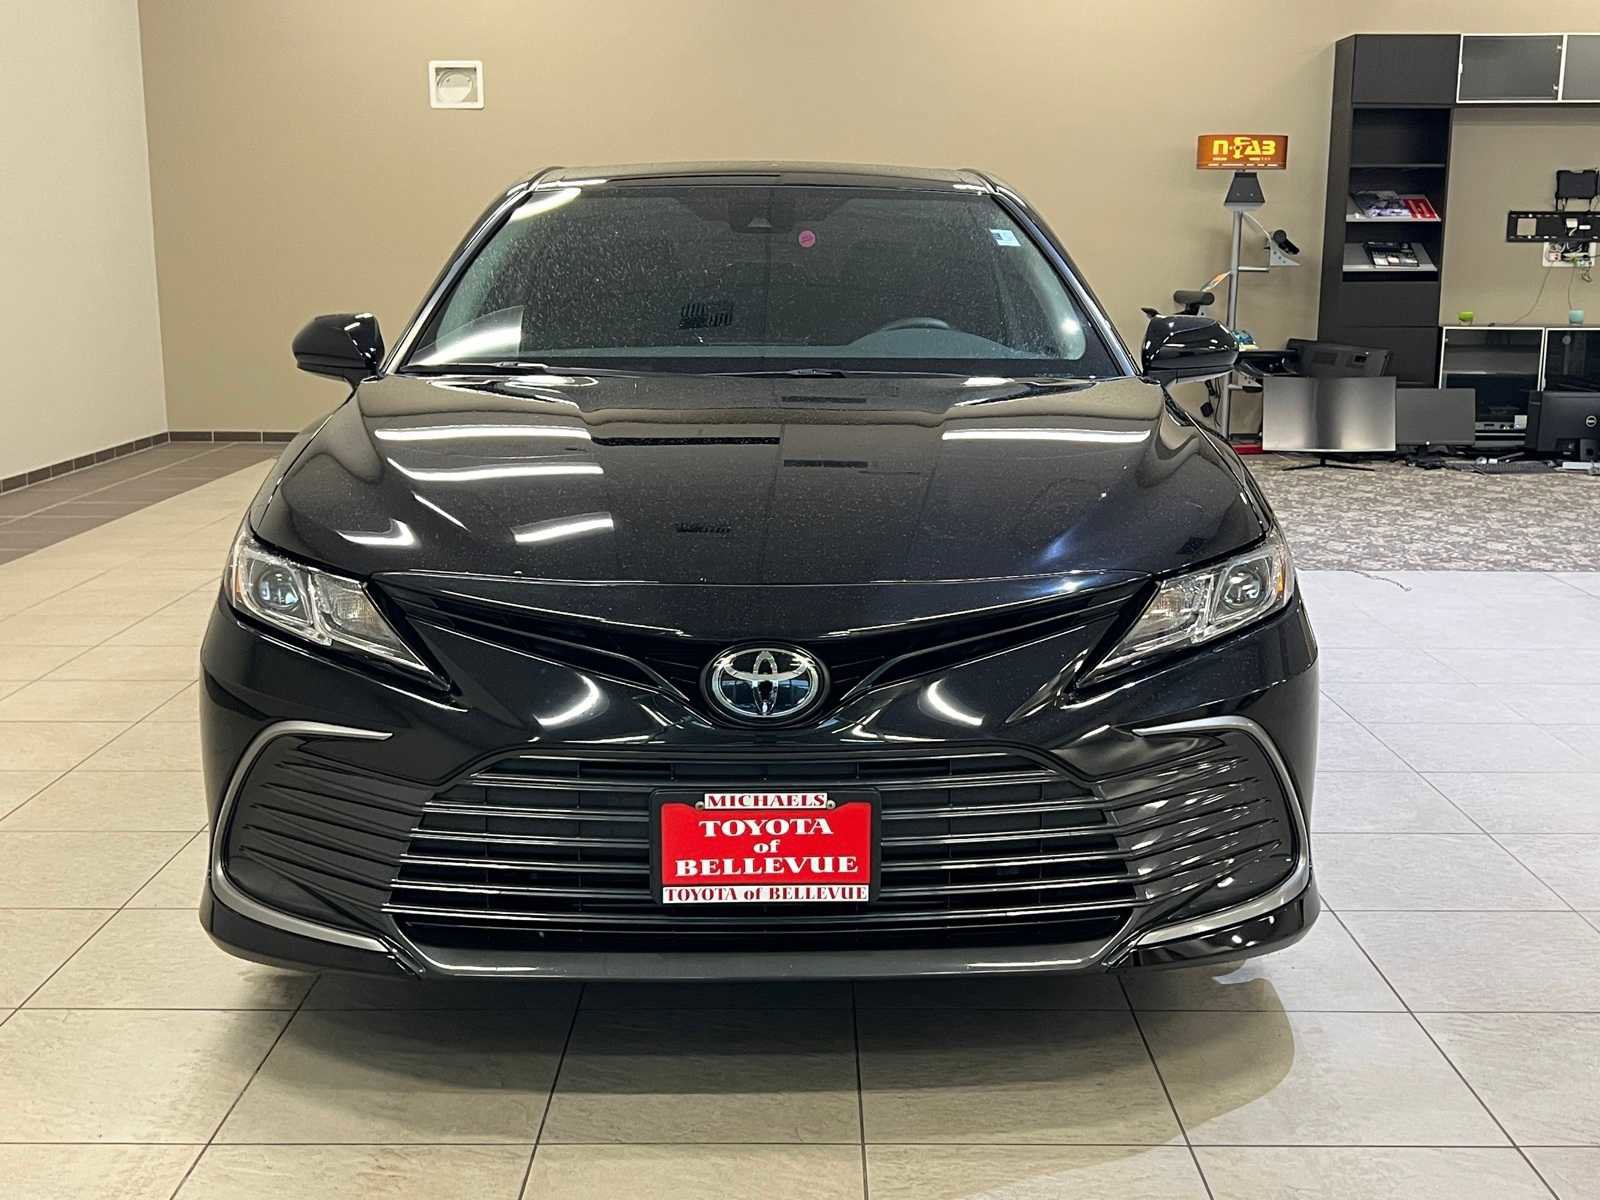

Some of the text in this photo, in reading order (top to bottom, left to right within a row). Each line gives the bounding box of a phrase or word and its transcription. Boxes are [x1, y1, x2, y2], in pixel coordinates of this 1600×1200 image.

[707, 794, 825, 807] MICHAELS
[699, 818, 834, 837] TOYOTA
[753, 839, 781, 854] of
[675, 856, 858, 877] BELLEVUE
[665, 886, 867, 901] TOYOTA of BELLEVUE
